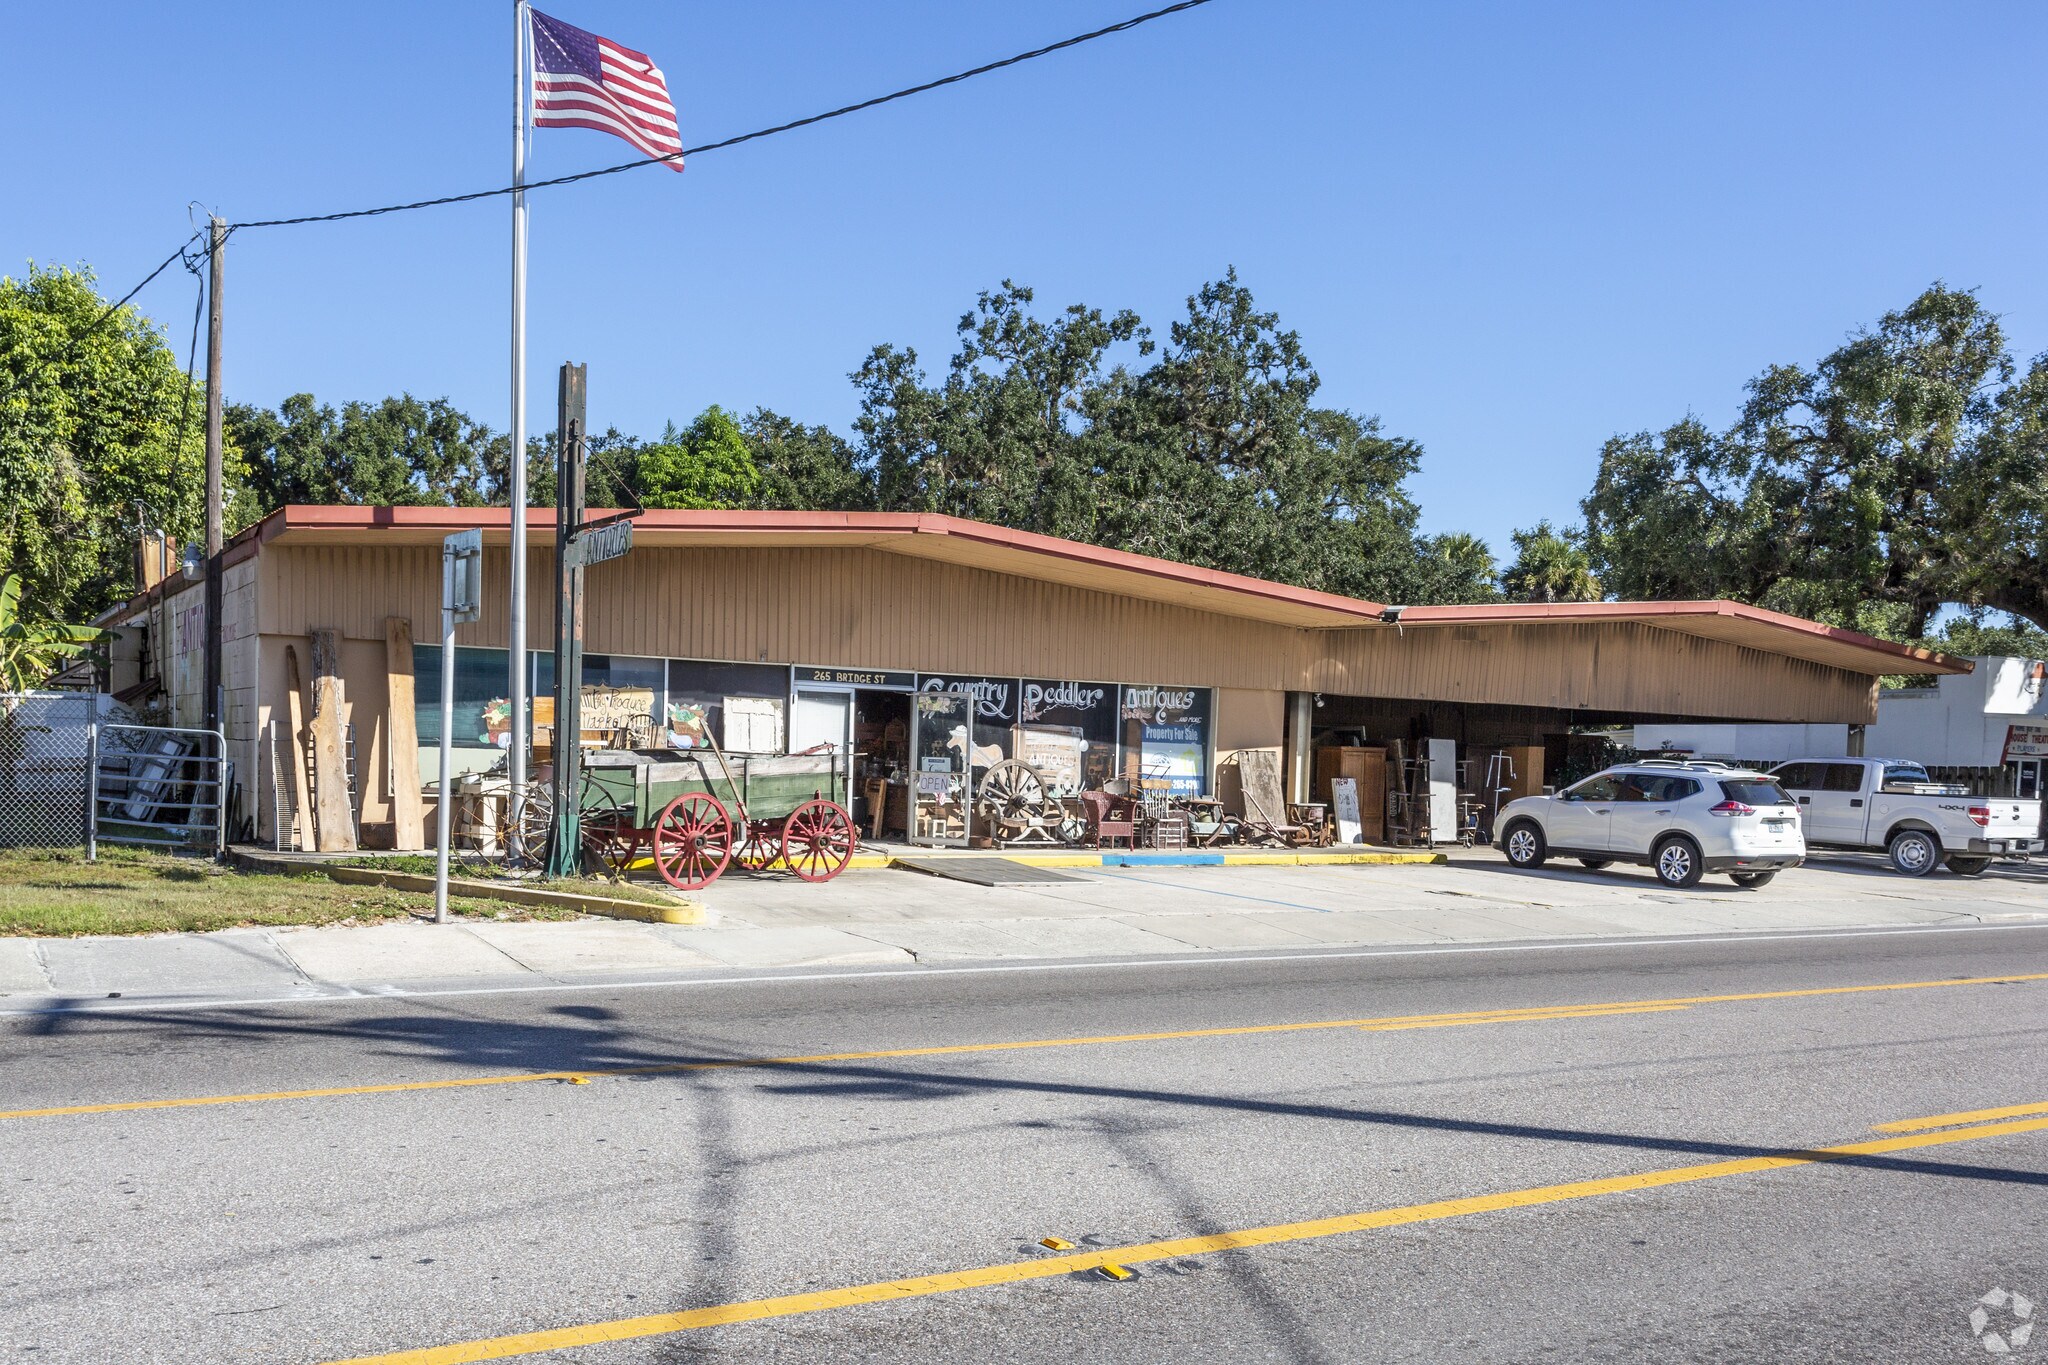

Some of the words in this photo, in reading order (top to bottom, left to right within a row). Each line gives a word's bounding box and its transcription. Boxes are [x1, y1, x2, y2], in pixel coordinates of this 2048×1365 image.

[586, 523, 628, 565] ANTIQUES
[814, 671, 831, 681] 265
[836, 672, 872, 684] BRIDGE
[874, 674, 886, 684] ST
[1025, 681, 1104, 713] Peddler
[1126, 686, 1196, 725] Antiques
[1145, 726, 1172, 741] Property
[1174, 727, 1184, 740] For
[1184, 727, 1199, 741] Sale
[920, 777, 948, 791] OPEN
